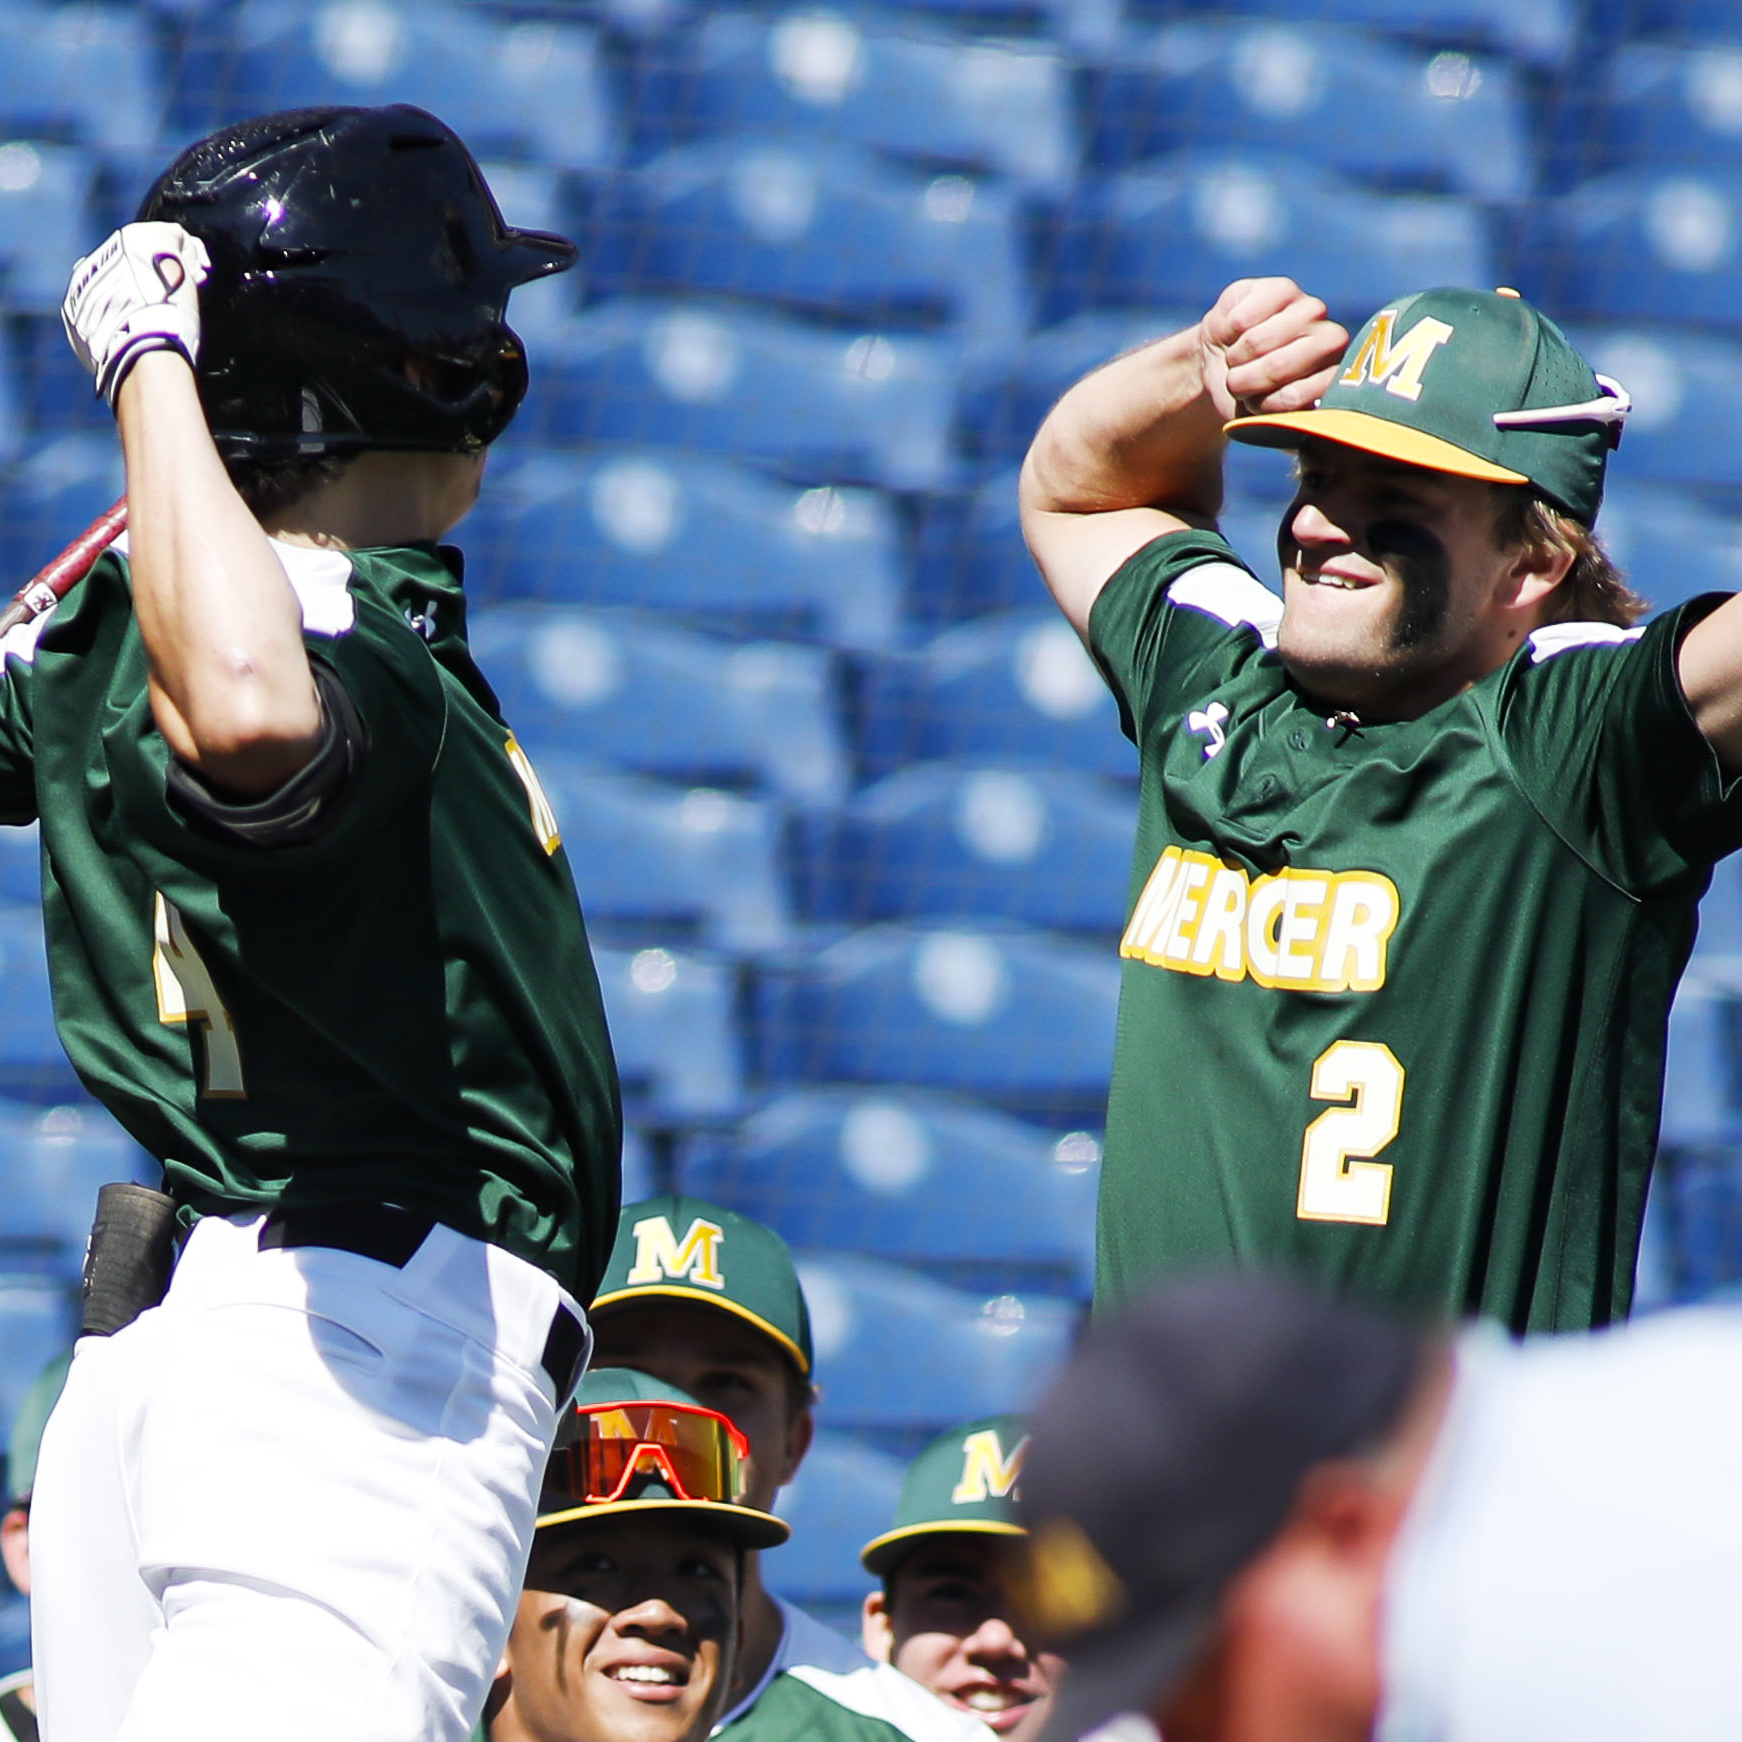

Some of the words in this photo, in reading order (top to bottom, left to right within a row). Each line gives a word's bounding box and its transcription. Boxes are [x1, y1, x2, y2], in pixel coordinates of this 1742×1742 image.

[1338, 310, 1454, 401] M
[1119, 844, 1401, 993] MERCER
[1296, 1039, 1406, 1226] 2
[627, 1216, 725, 1290] M
